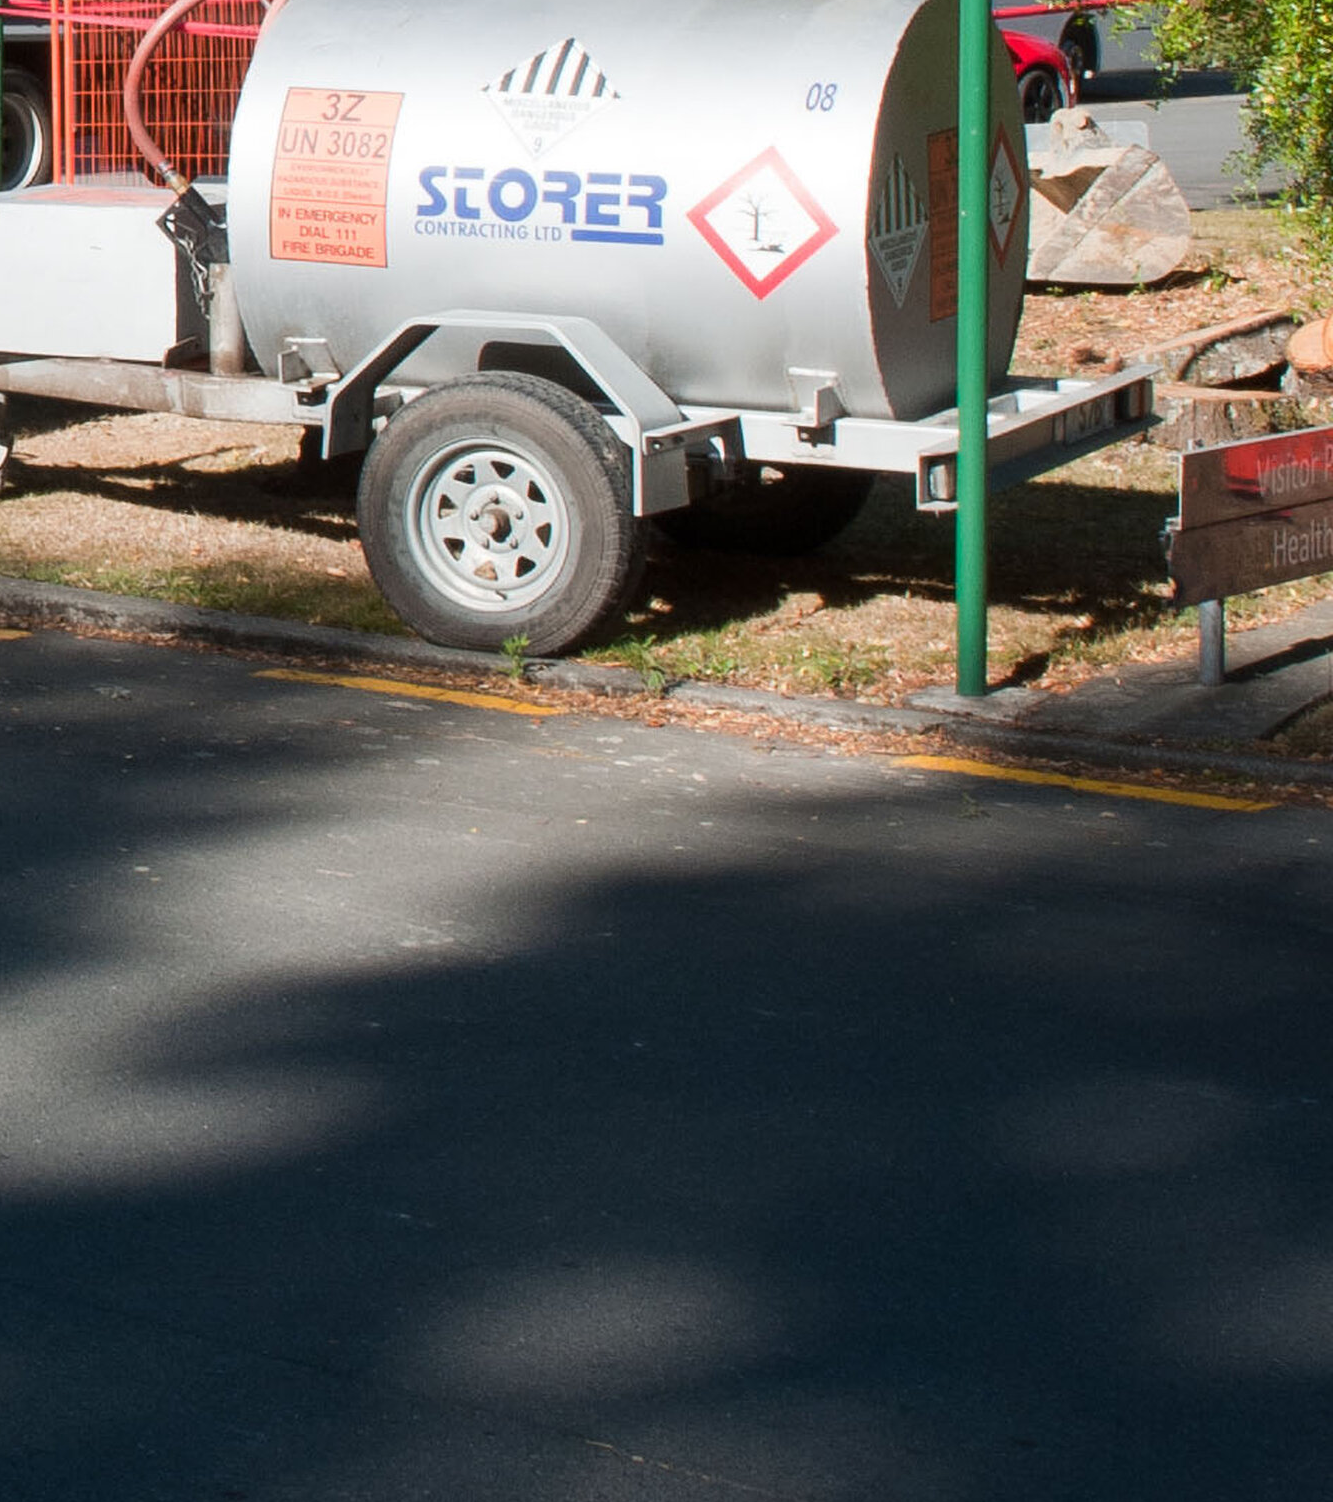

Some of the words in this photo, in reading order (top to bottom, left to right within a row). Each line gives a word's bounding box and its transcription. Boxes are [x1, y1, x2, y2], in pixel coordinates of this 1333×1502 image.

[321, 92, 366, 122] 3Z
[805, 82, 837, 112] 08
[281, 126, 319, 155] UN
[326, 130, 388, 159] 3082
[533, 135, 543, 154] 9
[416, 165, 668, 229] STORER
[277, 206, 291, 219] IN
[295, 207, 378, 227] EMERGENCY
[414, 219, 529, 241] CONTRACTING
[534, 225, 563, 242] LTD
[299, 224, 331, 239] DIAL
[336, 227, 358, 241] 111
[282, 240, 311, 254] FIRE
[315, 242, 375, 259] BRIGADE
[1257, 450, 1316, 497] Visitor
[1273, 516, 1333, 568] Health
